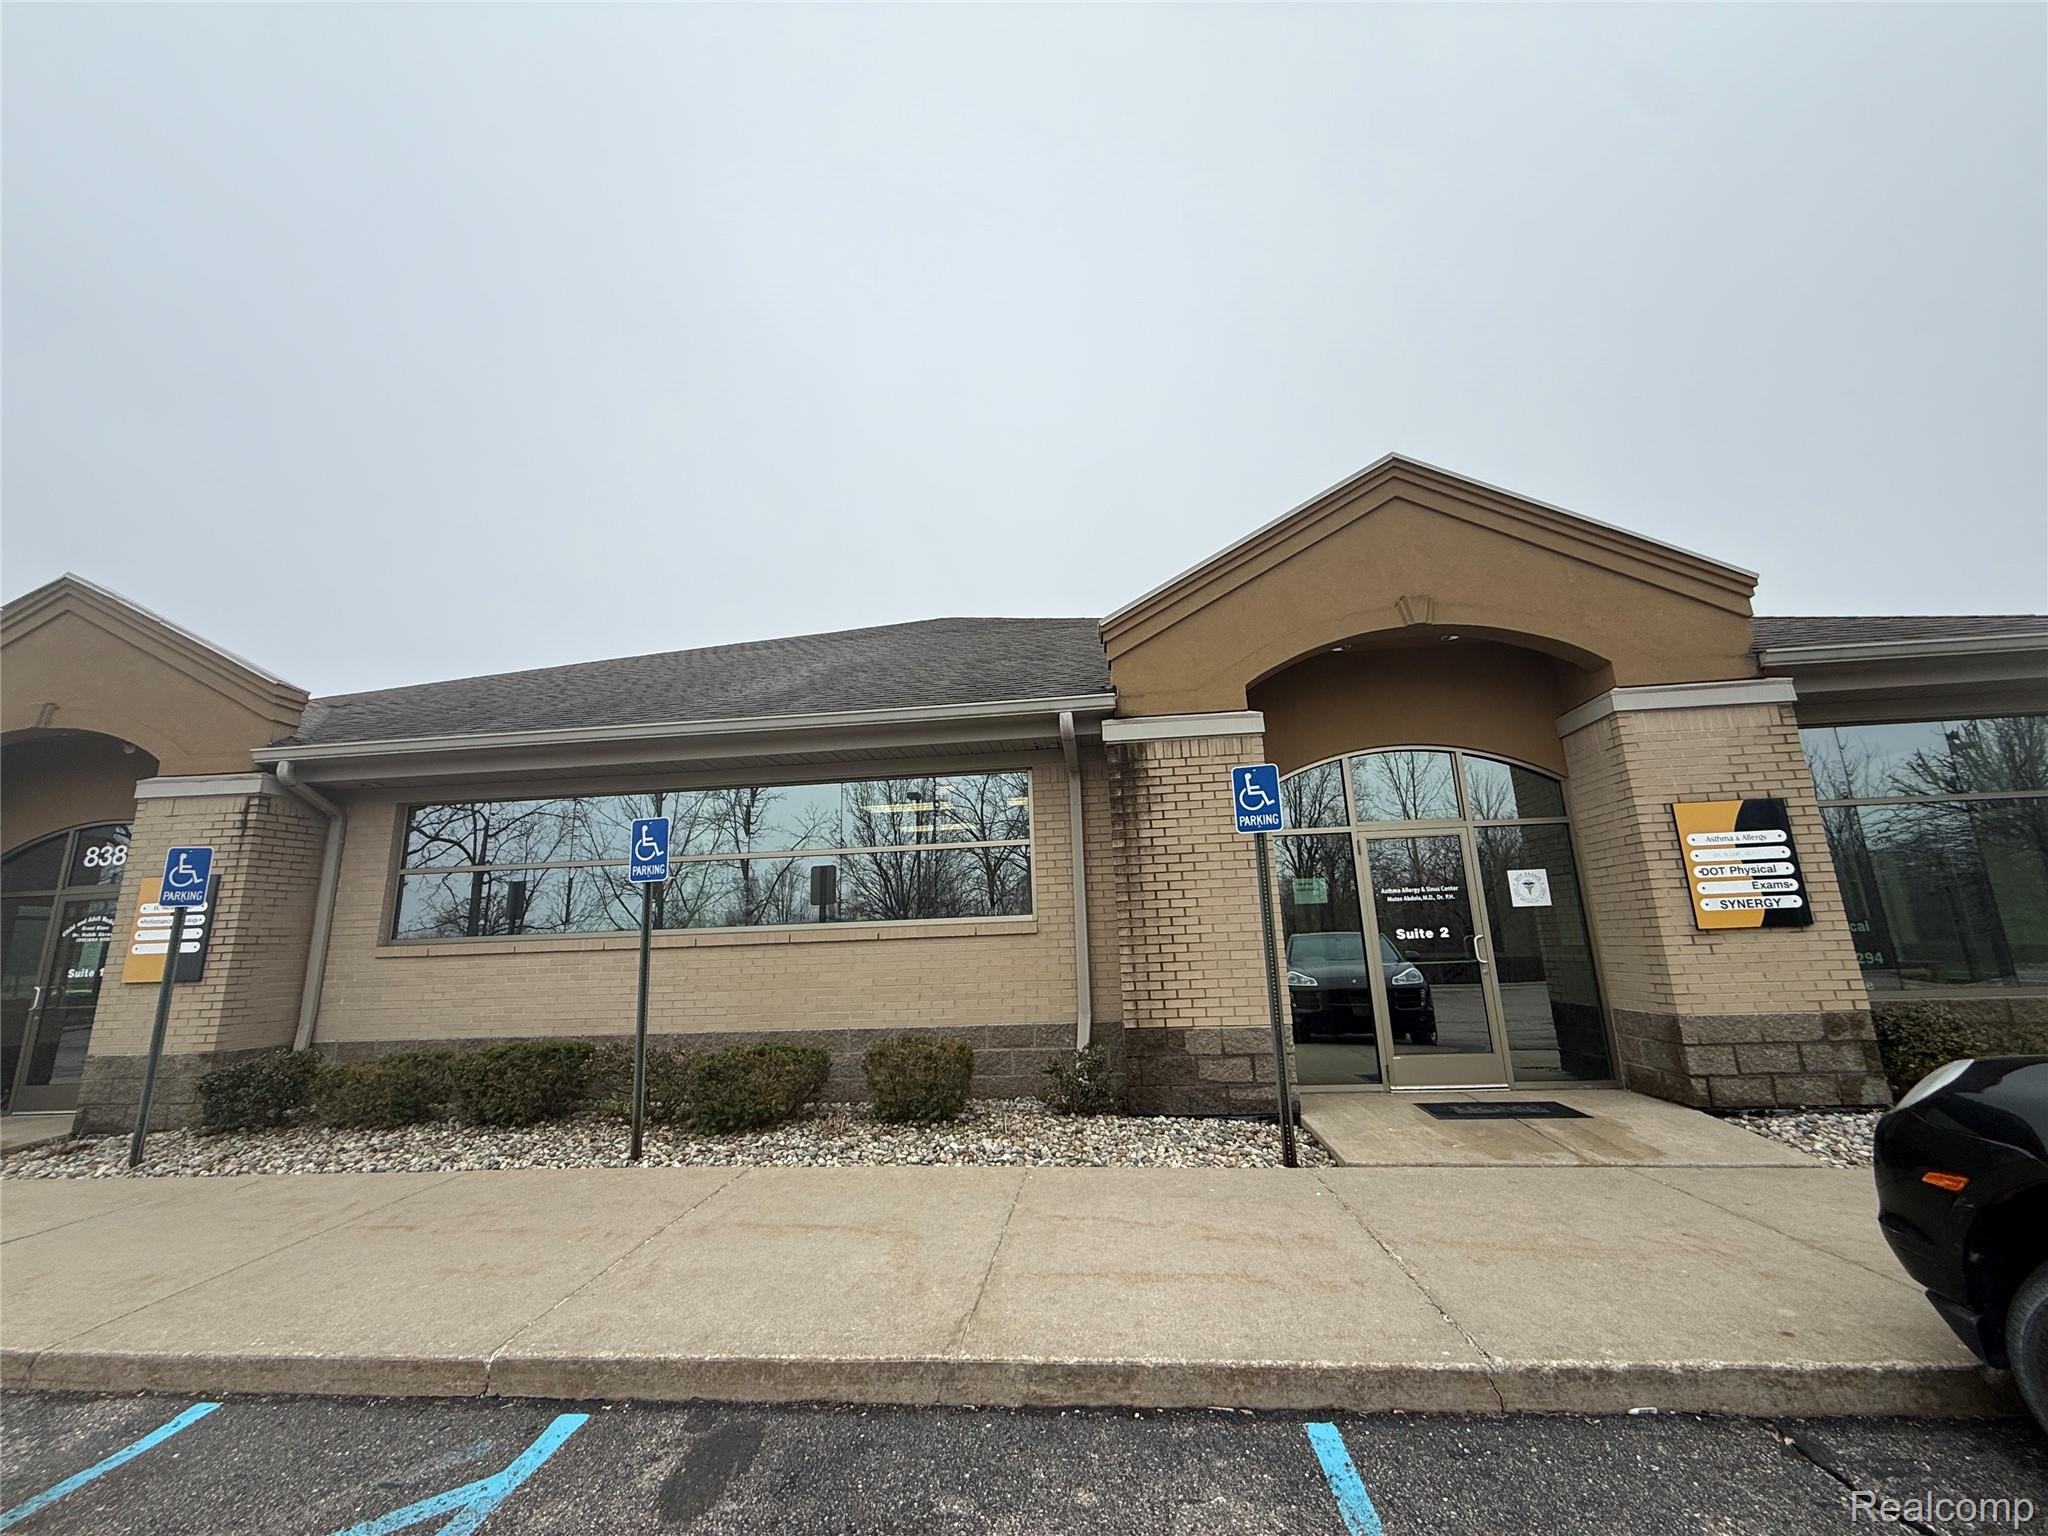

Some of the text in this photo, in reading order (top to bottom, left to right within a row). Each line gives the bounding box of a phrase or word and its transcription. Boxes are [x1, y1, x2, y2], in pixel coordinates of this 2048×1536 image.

[1240, 813, 1279, 827] PARKING
[1705, 835, 1734, 843] Asthma
[1742, 833, 1767, 842] Allergy
[632, 863, 665, 876] PARKING
[1701, 864, 1777, 876] DOT Physical
[1752, 881, 1790, 890] Exams
[162, 890, 204, 901] PARKING
[1720, 898, 1782, 909] SYNERGY
[1849, 920, 1870, 932] cal
[1396, 927, 1450, 940] Suite 2
[1856, 951, 1884, 964] 294
[67, 968, 95, 978] Suite
